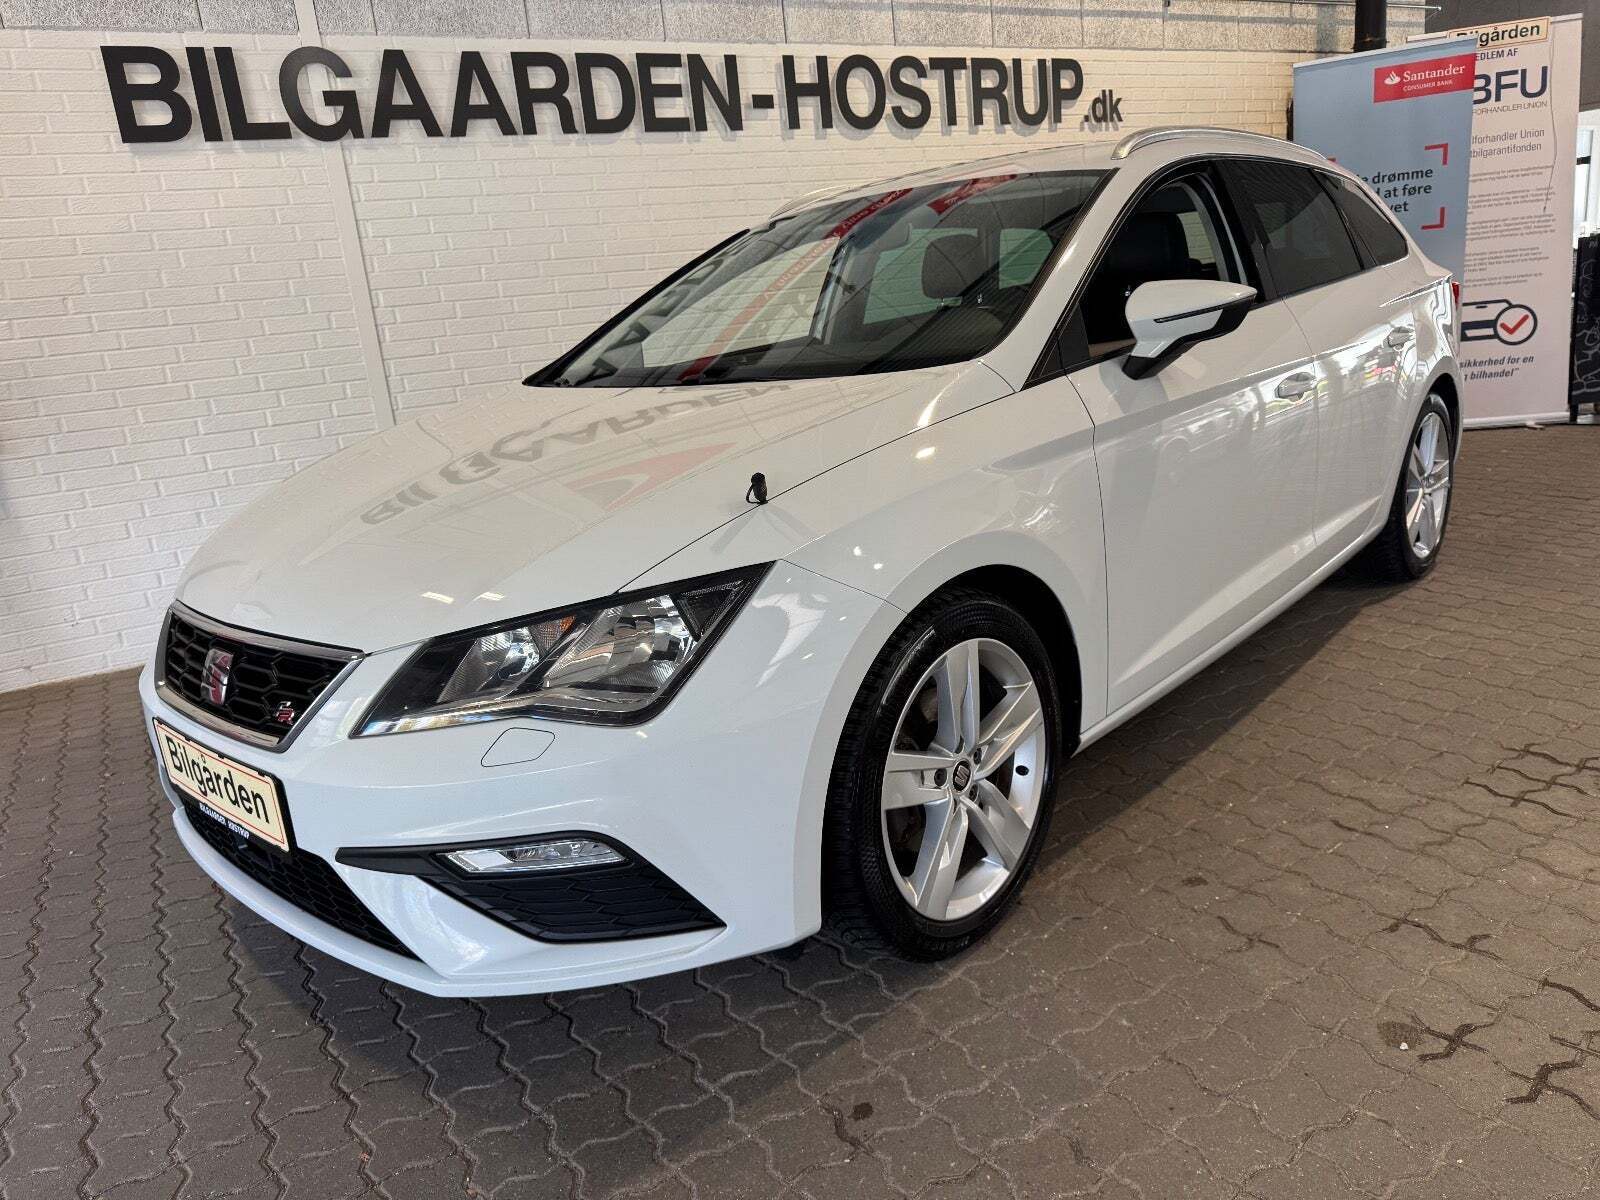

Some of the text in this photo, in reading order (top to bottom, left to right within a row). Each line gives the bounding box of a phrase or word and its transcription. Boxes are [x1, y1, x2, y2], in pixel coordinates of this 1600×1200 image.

[1456, 23, 1540, 47] gården
[1507, 47, 1519, 57] AF
[1402, 63, 1466, 83] Santander
[1403, 80, 1453, 92] CONSUMER BANK
[100, 45, 1123, 144] BILGAARDEN-HOSTRUP.dk
[1523, 100, 1548, 110] UNION
[1520, 128, 1545, 140] Union
[1372, 168, 1434, 185] drømme
[1383, 185, 1399, 199] at
[1402, 183, 1432, 197] føre
[1460, 353, 1535, 369] sikkerhed for en
[164, 734, 270, 824] Bilgården
